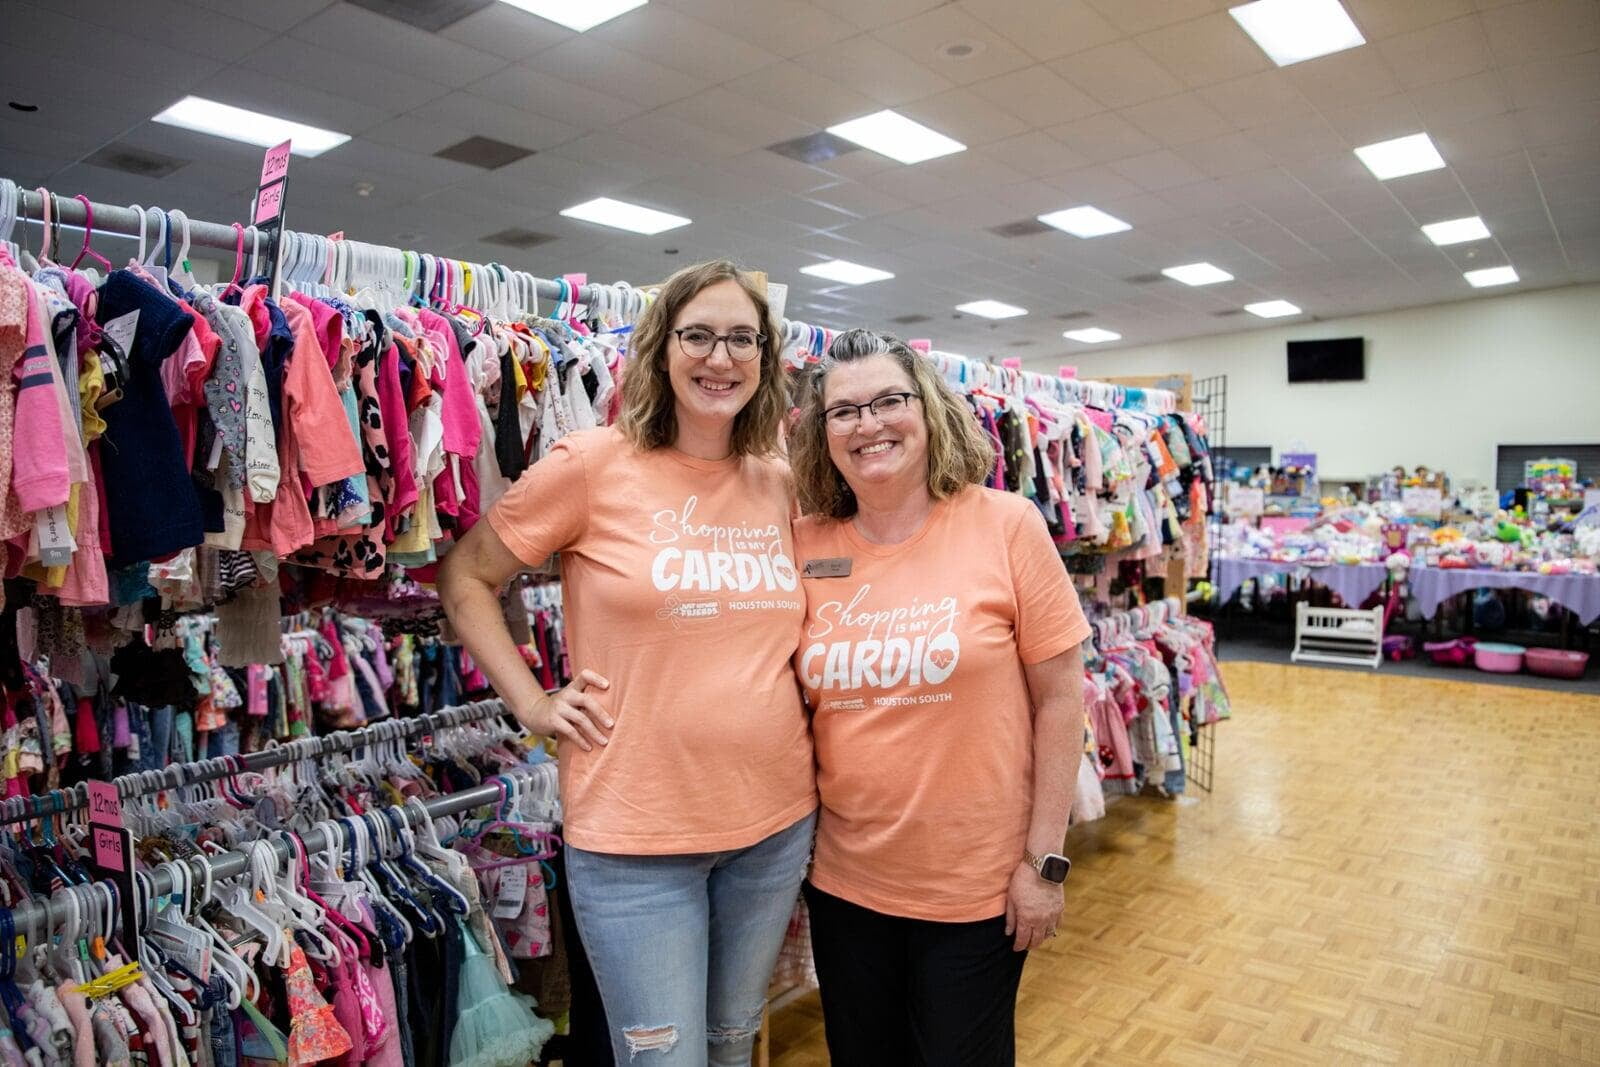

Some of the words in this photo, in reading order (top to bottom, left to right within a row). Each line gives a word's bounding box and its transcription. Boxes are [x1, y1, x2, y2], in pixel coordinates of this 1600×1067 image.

[649, 495, 783, 556] Shopping
[735, 542, 747, 550] IS
[749, 542, 766, 550] MY
[651, 546, 798, 592] CARDIO
[729, 600, 775, 610] HOUSTON
[808, 584, 960, 643] Shopping
[895, 624, 906, 633] IS
[910, 621, 929, 632] MY
[801, 632, 960, 690] CARDIO
[873, 695, 918, 706] HOUSTON
[919, 693, 952, 704] SOUTH
[99, 833, 120, 854] Girls
